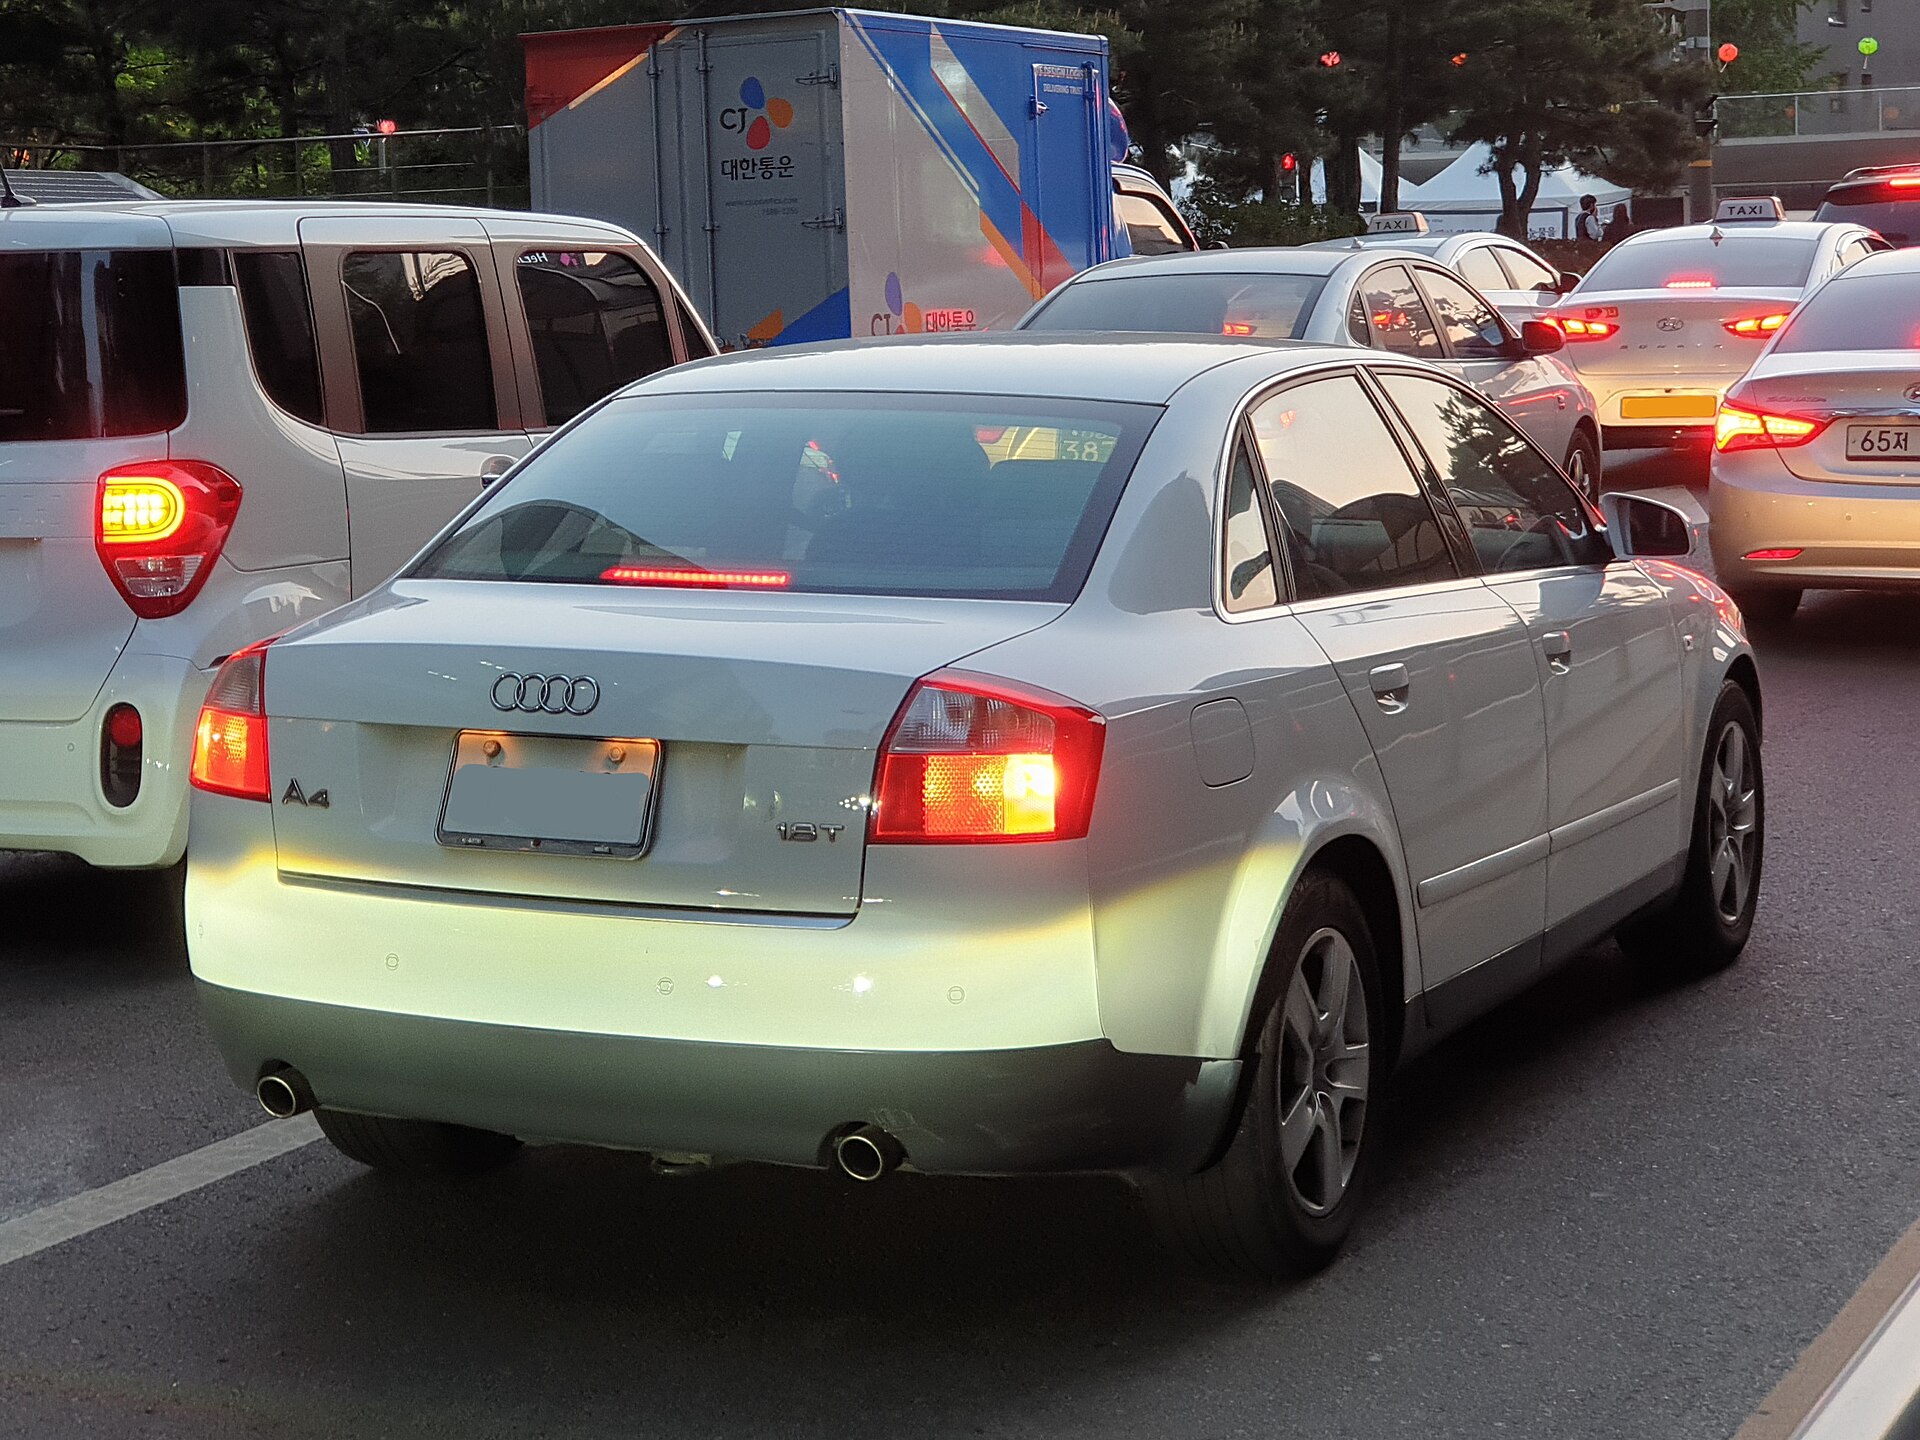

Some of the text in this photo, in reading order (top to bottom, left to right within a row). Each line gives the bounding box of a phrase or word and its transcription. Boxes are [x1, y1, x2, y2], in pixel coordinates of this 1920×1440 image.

[719, 108, 748, 134] CJ
[721, 155, 795, 181] 대한통운
[1727, 205, 1763, 216] TAXI
[1375, 220, 1408, 231] TAXI
[1861, 429, 1908, 452] 65저
[282, 777, 330, 809] A4
